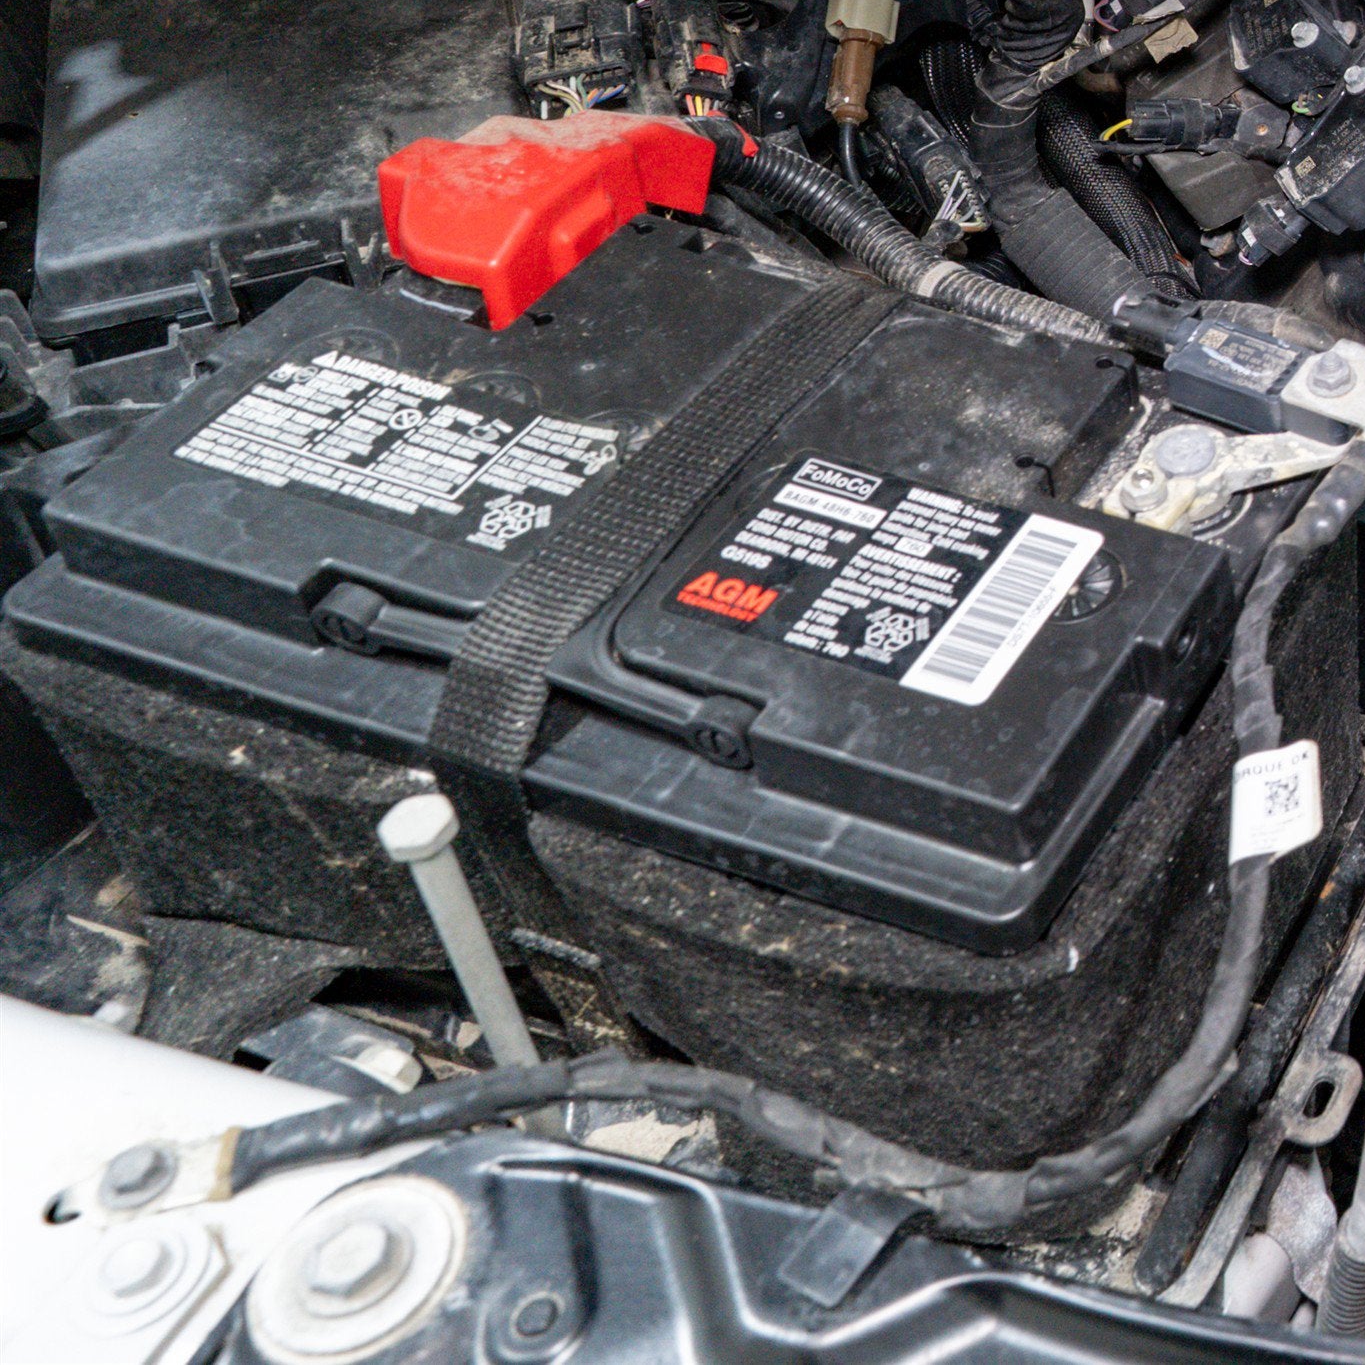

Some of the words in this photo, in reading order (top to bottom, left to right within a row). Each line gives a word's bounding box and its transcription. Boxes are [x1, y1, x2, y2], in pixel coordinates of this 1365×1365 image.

[799, 463, 876, 495] FoMoCo
[904, 486, 967, 513] WARNING:
[781, 514, 803, 528] BY
[807, 537, 832, 552] CO.
[899, 540, 927, 553] 760
[856, 542, 957, 581] AVERTISSEMENT
[681, 568, 780, 614] AGM
[673, 590, 759, 623] TECHNOLOGY
